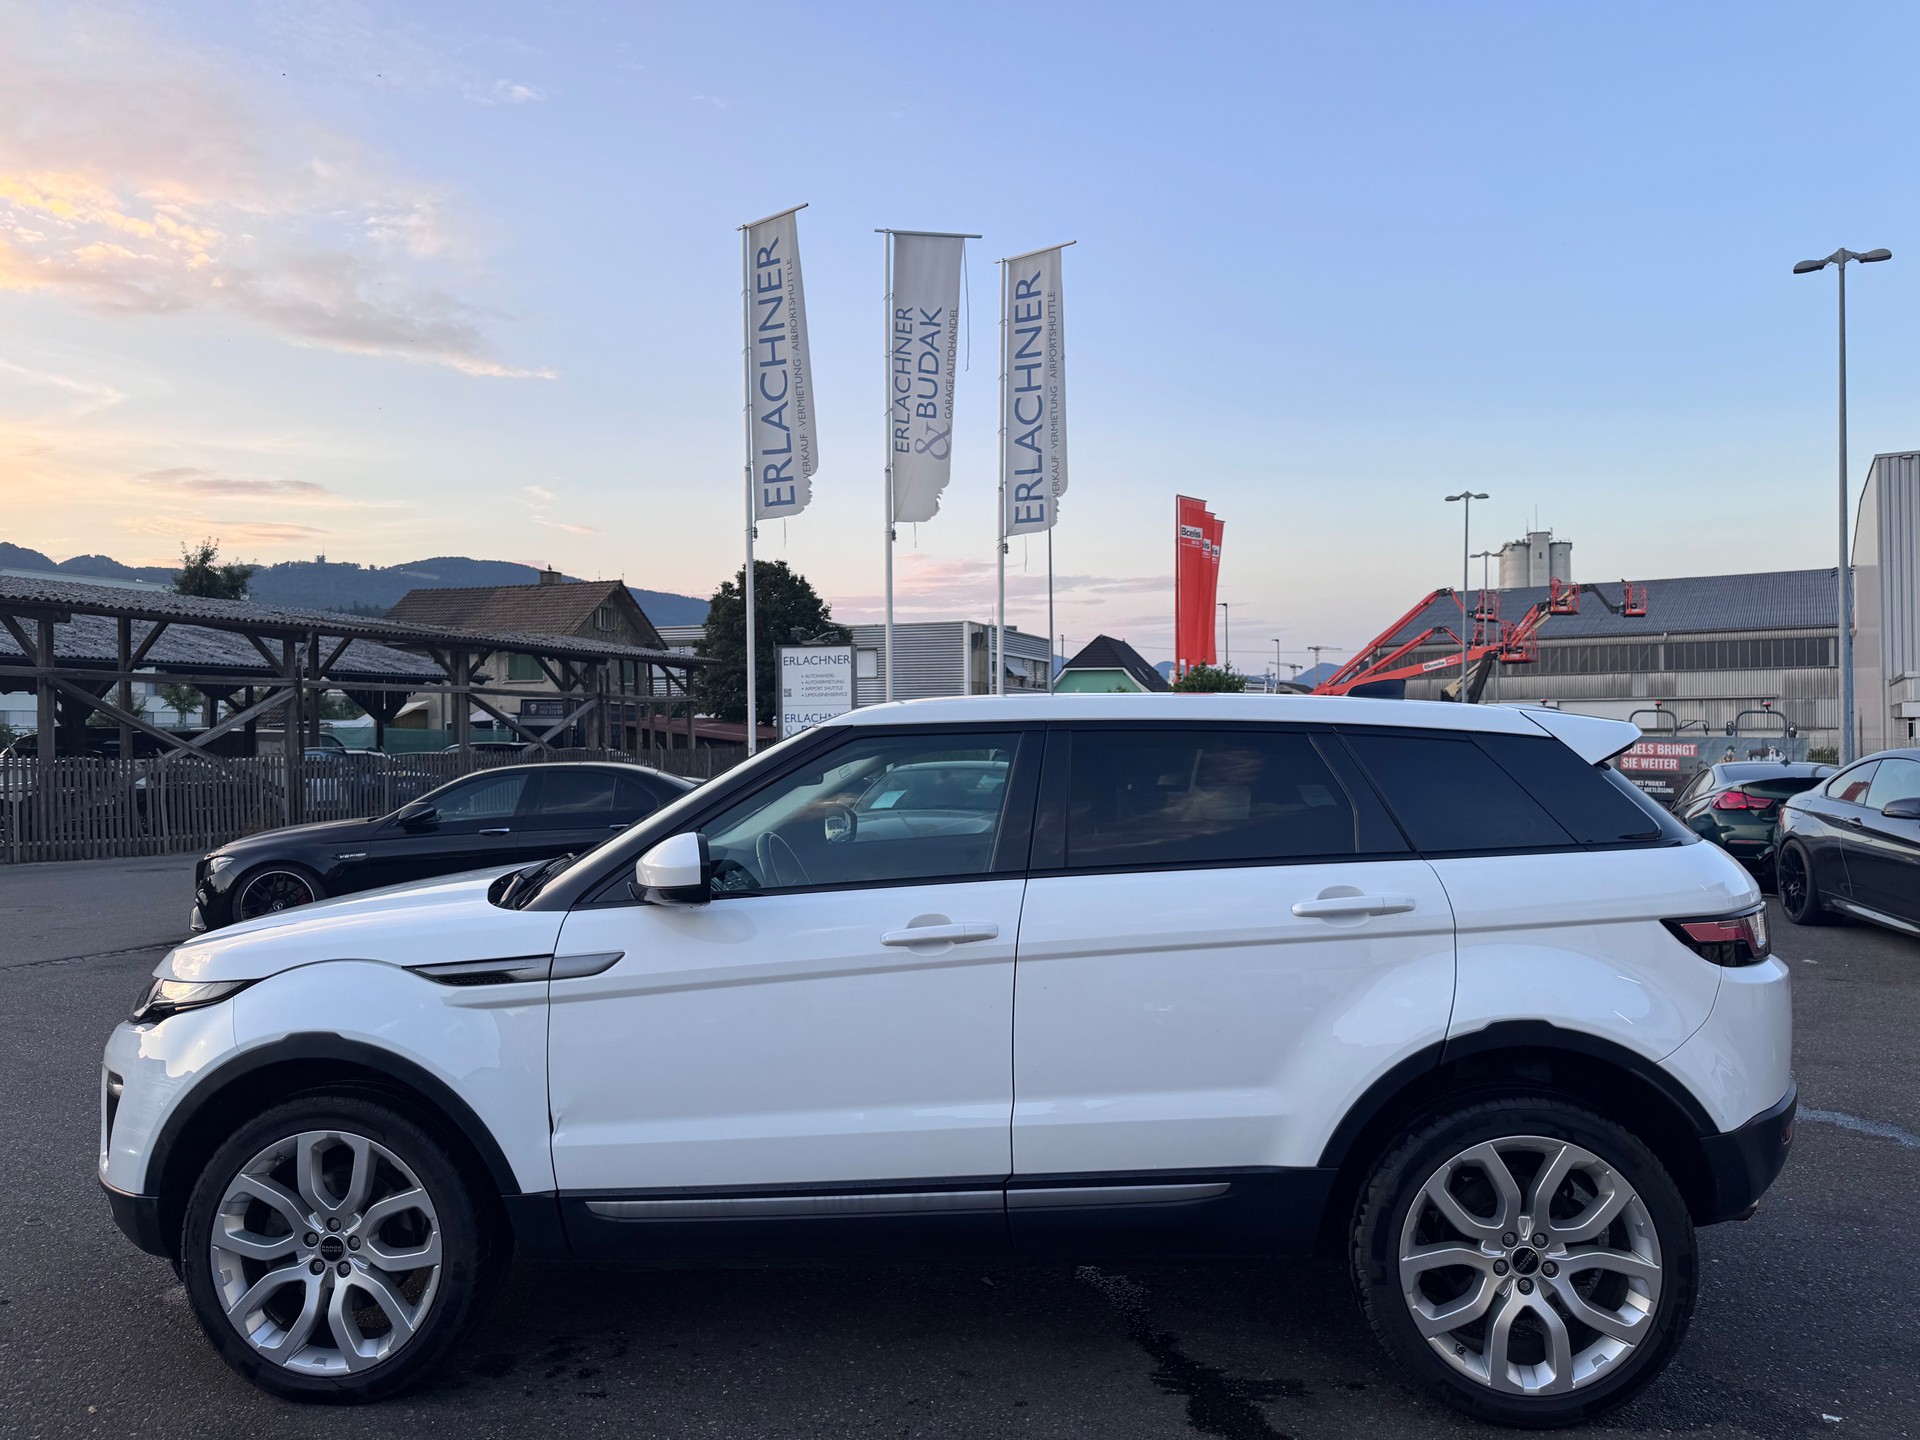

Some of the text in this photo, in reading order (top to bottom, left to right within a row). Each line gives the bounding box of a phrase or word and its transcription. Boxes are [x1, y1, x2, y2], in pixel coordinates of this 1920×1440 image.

[756, 236, 796, 507] ERLACHNER
[786, 258, 812, 479] VERKAUF VERMIETUNG AIRPORTSHUTTLE
[894, 307, 914, 453] ERLACHNER
[914, 307, 951, 460] & BUDAK
[944, 307, 959, 419] GARAGE AUTOHANDEL
[1014, 270, 1045, 525] ERLACHNER
[1047, 292, 1061, 498] VERKAUF VERMIETUNG AIRPORTSHUTTLE
[783, 655, 851, 666] ERLACHNER
[1622, 757, 1677, 769] SIE WEITER
[1657, 744, 1696, 755] BRINGT
